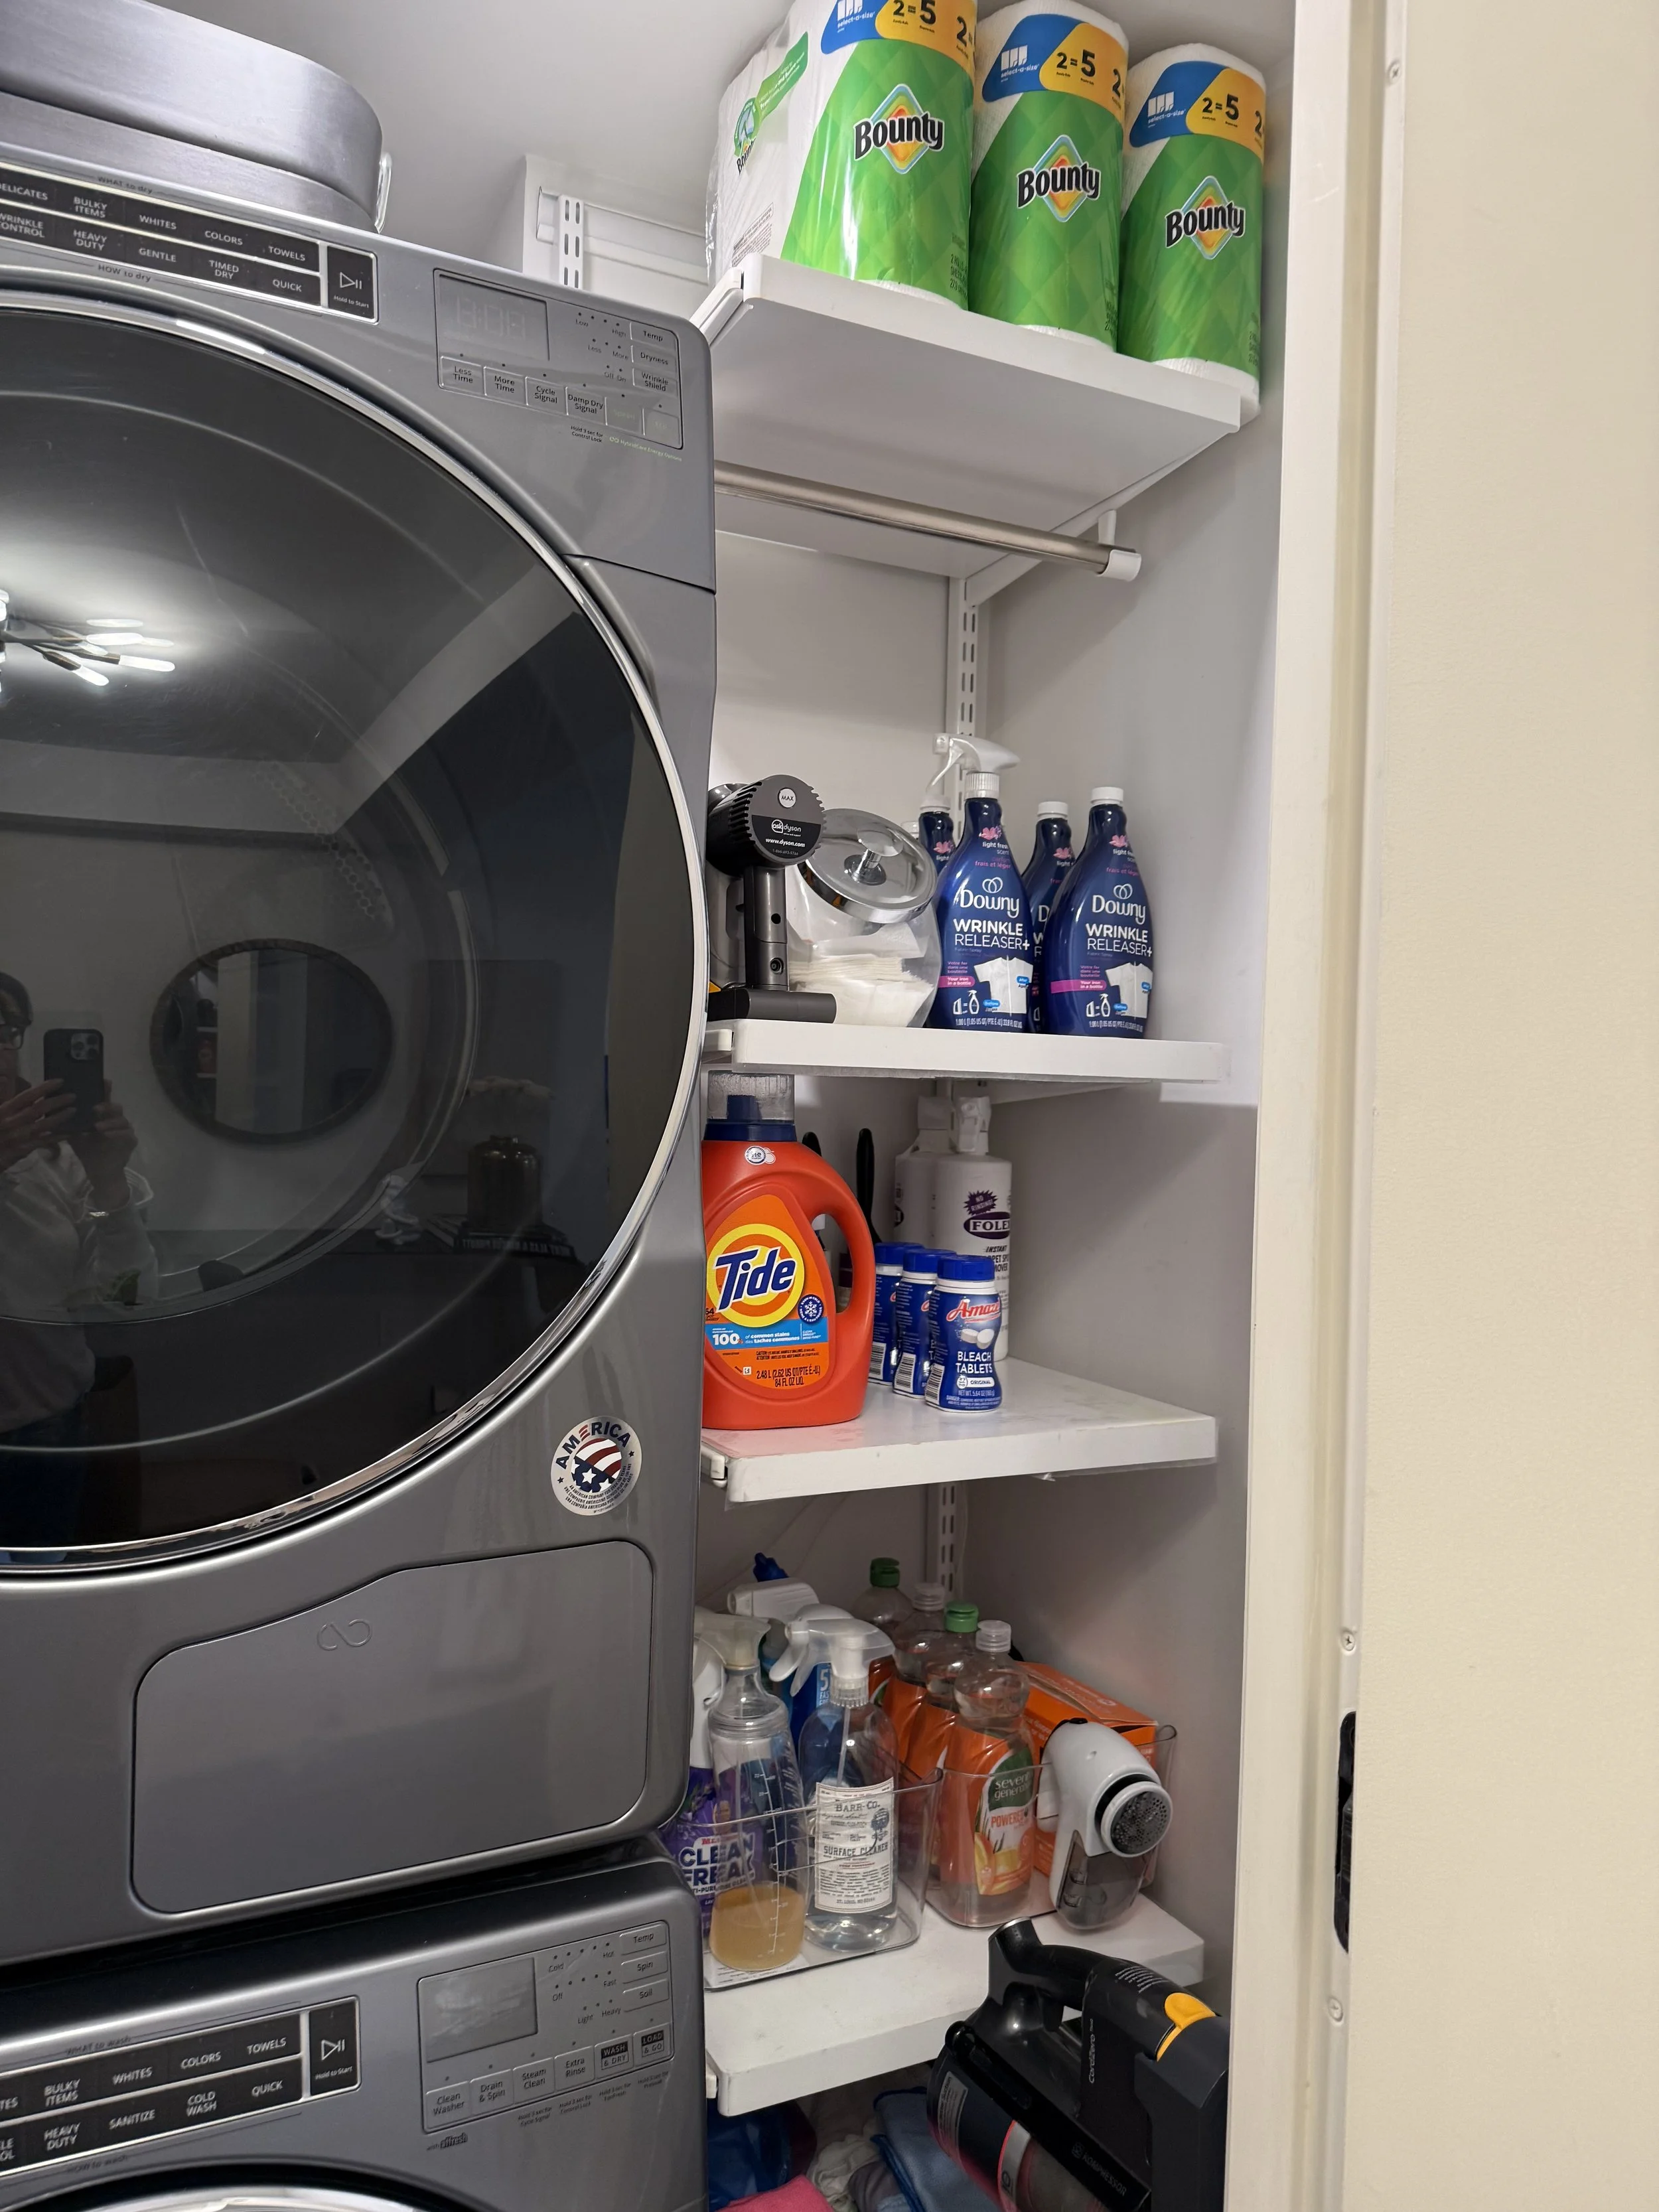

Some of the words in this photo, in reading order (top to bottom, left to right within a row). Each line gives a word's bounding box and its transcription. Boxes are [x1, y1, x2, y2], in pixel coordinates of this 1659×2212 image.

[837, 11, 874, 29] select-a-size
[854, 111, 944, 160] Bounty
[98, 176, 123, 187] WHAT
[137, 184, 153, 194] dry
[1017, 162, 1101, 208] Bounty
[73, 196, 108, 210] BULKY
[74, 205, 106, 218] ITEMS
[139, 214, 177, 230] WHITES
[1165, 201, 1246, 248] Bounty
[73, 230, 108, 244] HEAVY
[204, 230, 243, 246] COLORS
[76, 239, 104, 252] DUTY
[138, 248, 177, 262] GENTLE
[269, 246, 306, 261] TOWELS
[208, 259, 240, 273] TIMED
[98, 264, 121, 275] HOW
[136, 272, 151, 283] dry
[214, 269, 234, 280] DRY
[272, 279, 303, 292] QUICK
[334, 295, 348, 303] Hold
[355, 300, 369, 309] Start
[575, 319, 589, 327] Low
[612, 329, 626, 338] High
[643, 331, 663, 342] Temp
[588, 344, 602, 354] Less
[613, 351, 629, 360] More
[640, 352, 669, 365] Dryness
[455, 366, 472, 376] Less
[453, 373, 473, 384] Time
[494, 376, 515, 386] More
[641, 372, 668, 385] Wrinkle
[495, 383, 515, 394] Time
[536, 385, 555, 396] Cycle
[644, 380, 666, 392] Shield
[534, 392, 557, 404] Signal
[568, 394, 589, 406] Damp
[591, 400, 603, 409] Dry
[575, 403, 597, 414] Signal
[784, 824, 802, 832] dyson
[765, 838, 806, 848] www.dyson.com
[960, 889, 1020, 919] Downy
[1092, 895, 1146, 925] Downy
[953, 919, 1023, 936] WRINKLE
[1086, 922, 1149, 943] WRINKLE
[955, 934, 1030, 951] RELEASER+
[1087, 938, 1153, 957] RELEASER+
[972, 1221, 1009, 1230] FOLE
[714, 1248, 796, 1311] Tide
[958, 1351, 991, 1362] BLEACH
[757, 1370, 767, 1379] 2.48
[785, 1368, 791, 1376] US
[956, 1363, 993, 1374] TABLETS
[775, 1378, 780, 1387] 84
[555, 1422, 631, 1470] AMERICA
[572, 1488, 588, 1499] AMERICAN
[835, 1801, 880, 1812] BARR-CO.
[680, 1834, 754, 1867] CLEAN
[824, 1846, 856, 1856] SURFACE
[633, 1933, 654, 1944] Temp
[548, 1962, 564, 1972] Cold
[637, 1961, 654, 1972] Spin
[603, 1978, 616, 1988] Fast
[552, 1992, 563, 2002] Off
[640, 1988, 653, 1999] Soil
[602, 2006, 621, 2018] Heavy
[577, 2014, 593, 2025] Light
[642, 2032, 662, 2044] LOAD
[66, 2044, 93, 2055] WHAT
[247, 2037, 287, 2055] TOWELS
[603, 2044, 626, 2057] WASH
[652, 2043, 663, 2052] GO
[180, 2051, 222, 2070] COLORS
[565, 2057, 585, 2069] Extra
[611, 2054, 627, 2065] DRY
[112, 2067, 153, 2085] WHITES
[315, 2071, 330, 2080] Hold
[338, 2065, 353, 2075] Start
[522, 2067, 546, 2082] Steam
[565, 2067, 586, 2078] Rinse
[44, 2079, 80, 2097] BULKY
[252, 2080, 283, 2097] QUICK
[480, 2079, 503, 2093] Drain
[524, 2077, 545, 2090] Clean
[45, 2091, 78, 2107] ITEMS
[186, 2091, 216, 2106] COLD
[437, 2092, 461, 2105] Clean
[488, 2089, 506, 2101] Spin
[186, 2101, 217, 2117] WASH
[433, 2100, 465, 2116] Washer
[109, 2109, 155, 2130] SANITIZE
[44, 2123, 80, 2142] HEAVY
[46, 2135, 77, 2151] DUTY
[440, 2132, 468, 2148] affresh
